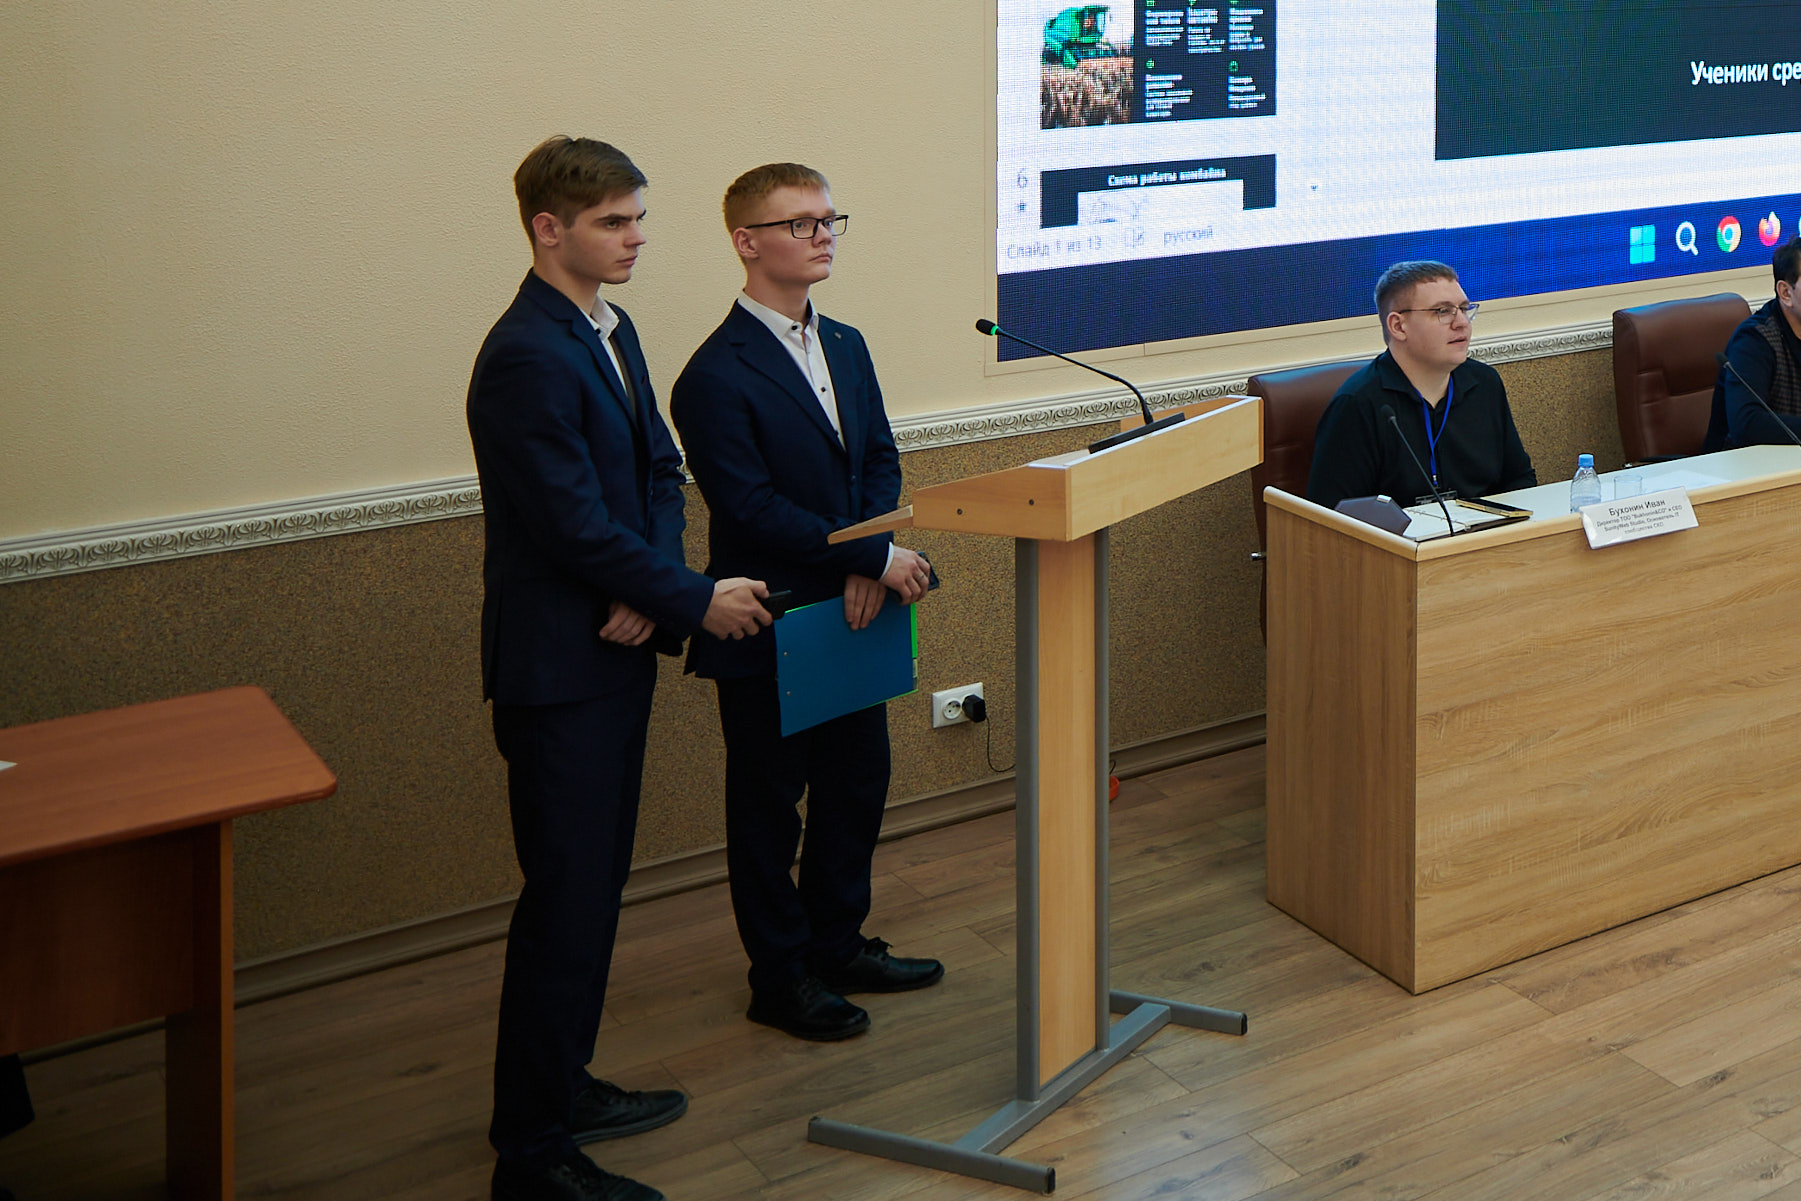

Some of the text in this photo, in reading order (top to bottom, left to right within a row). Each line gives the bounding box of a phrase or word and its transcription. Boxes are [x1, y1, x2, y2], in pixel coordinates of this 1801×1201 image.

[1690, 60, 1769, 87] Ученики
[1107, 174, 1138, 187] Схема
[1163, 225, 1214, 247] русский
[1007, 241, 1050, 260] Слайд
[1608, 498, 1666, 517] Бухонин Иван
